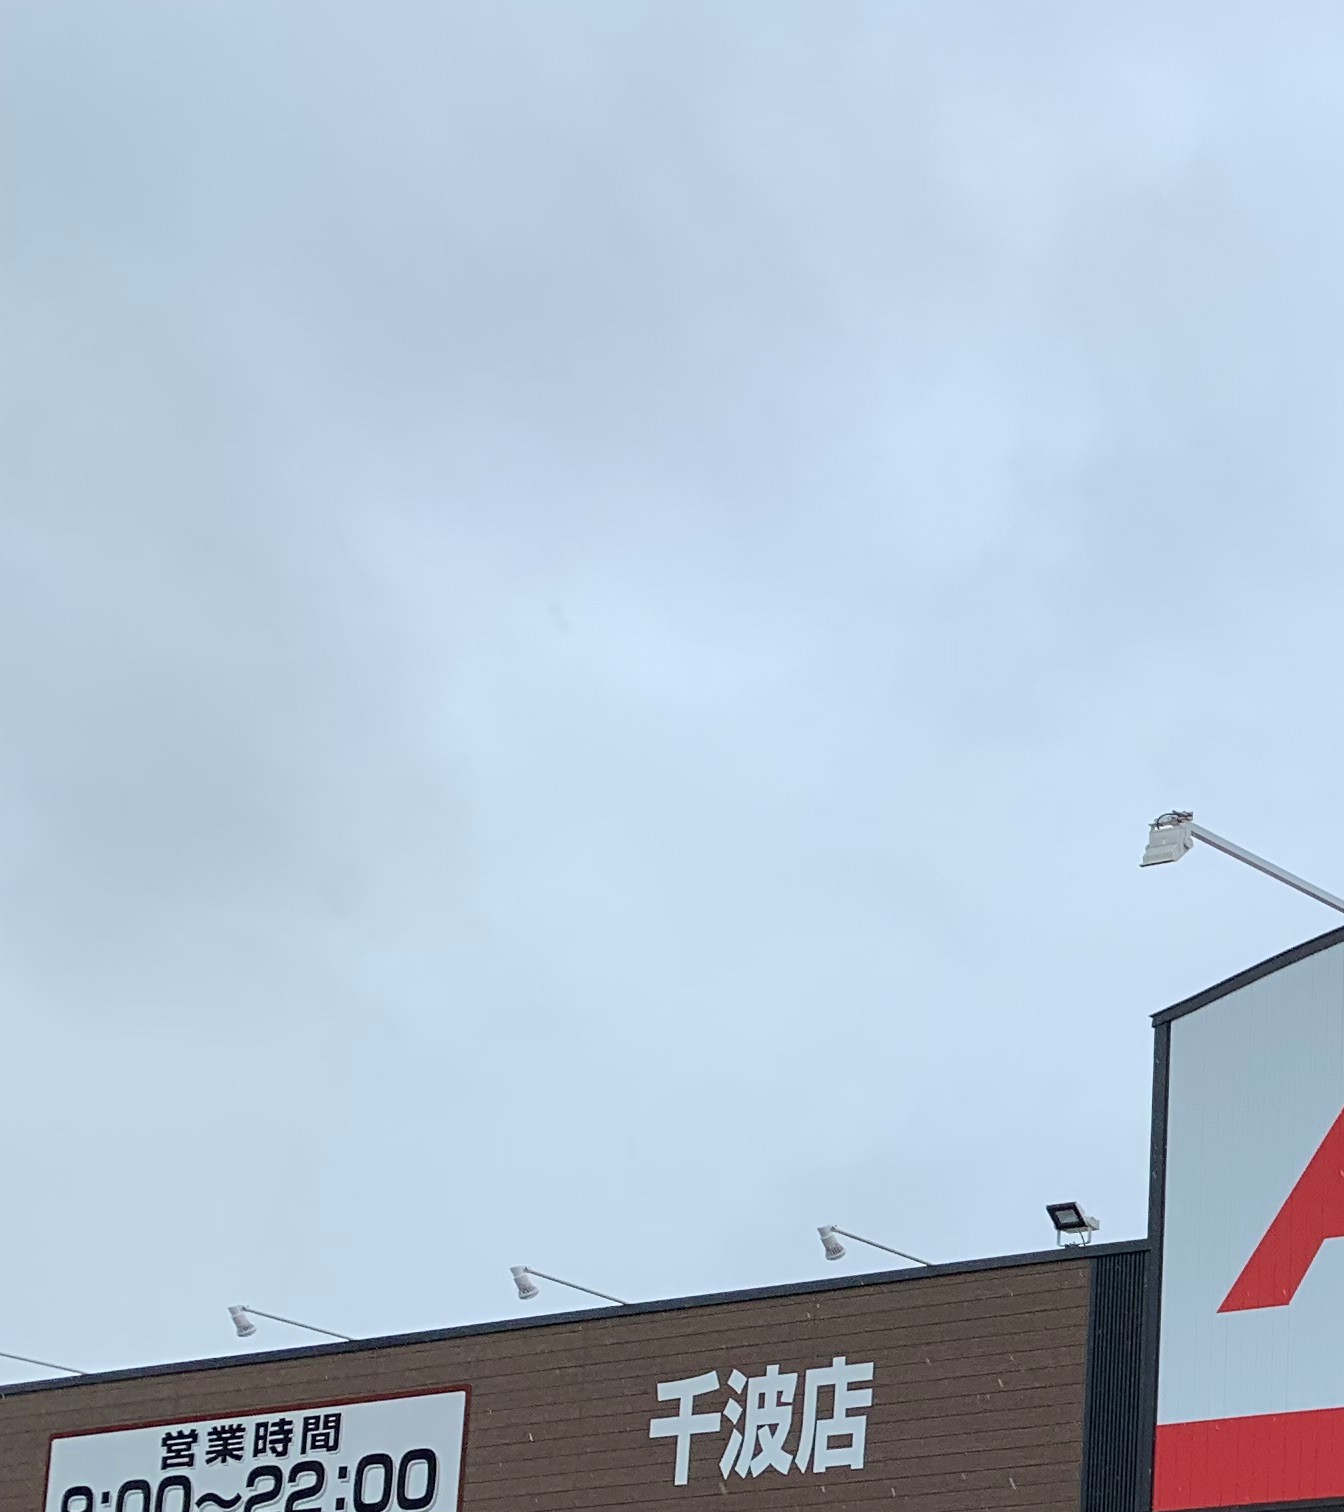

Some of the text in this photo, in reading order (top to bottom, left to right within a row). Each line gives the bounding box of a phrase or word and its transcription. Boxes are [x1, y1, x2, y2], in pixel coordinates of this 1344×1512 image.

[160, 1412, 343, 1470] 営業時間
[648, 1355, 875, 1486] 千波店
